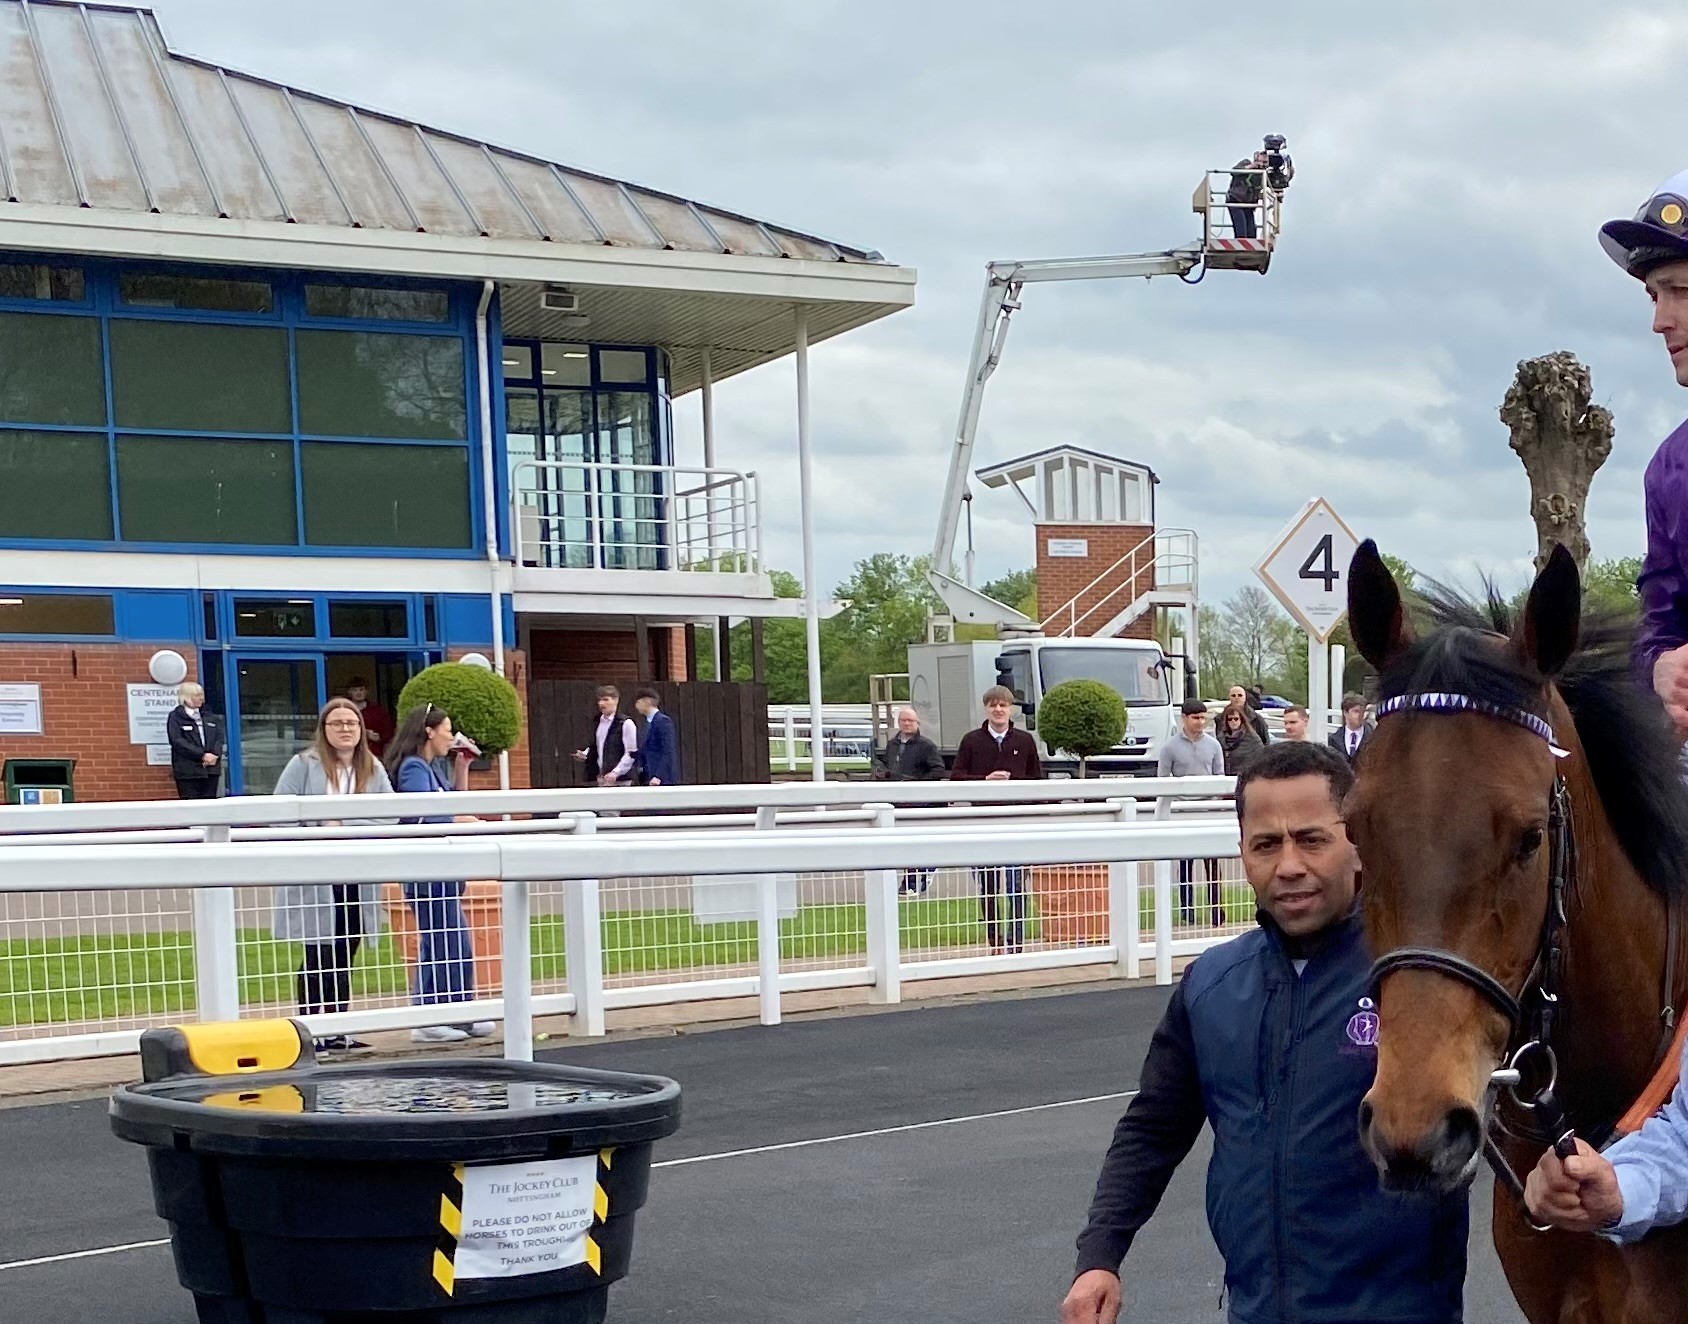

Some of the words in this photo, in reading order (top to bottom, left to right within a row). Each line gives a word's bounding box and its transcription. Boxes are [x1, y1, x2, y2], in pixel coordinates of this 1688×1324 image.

[1298, 534, 1340, 592] 4
[144, 699, 177, 707] STAND
[513, 1180, 551, 1194] JOCKEY
[552, 1177, 579, 1188] CLUB
[507, 1192, 561, 1203] NOTTINGHAM
[472, 1216, 512, 1227] PLEASE
[514, 1215, 530, 1225] DO
[532, 1212, 553, 1222] NOT
[554, 1208, 588, 1219] ALLOW
[464, 1229, 508, 1240] HORSES
[511, 1228, 525, 1237] TO
[526, 1225, 557, 1236] DRINK
[558, 1221, 578, 1231] OUT
[579, 1218, 592, 1228] OF
[497, 1240, 520, 1250] THIS
[500, 1255, 535, 1265] THANK
[537, 1252, 558, 1261] YOU
